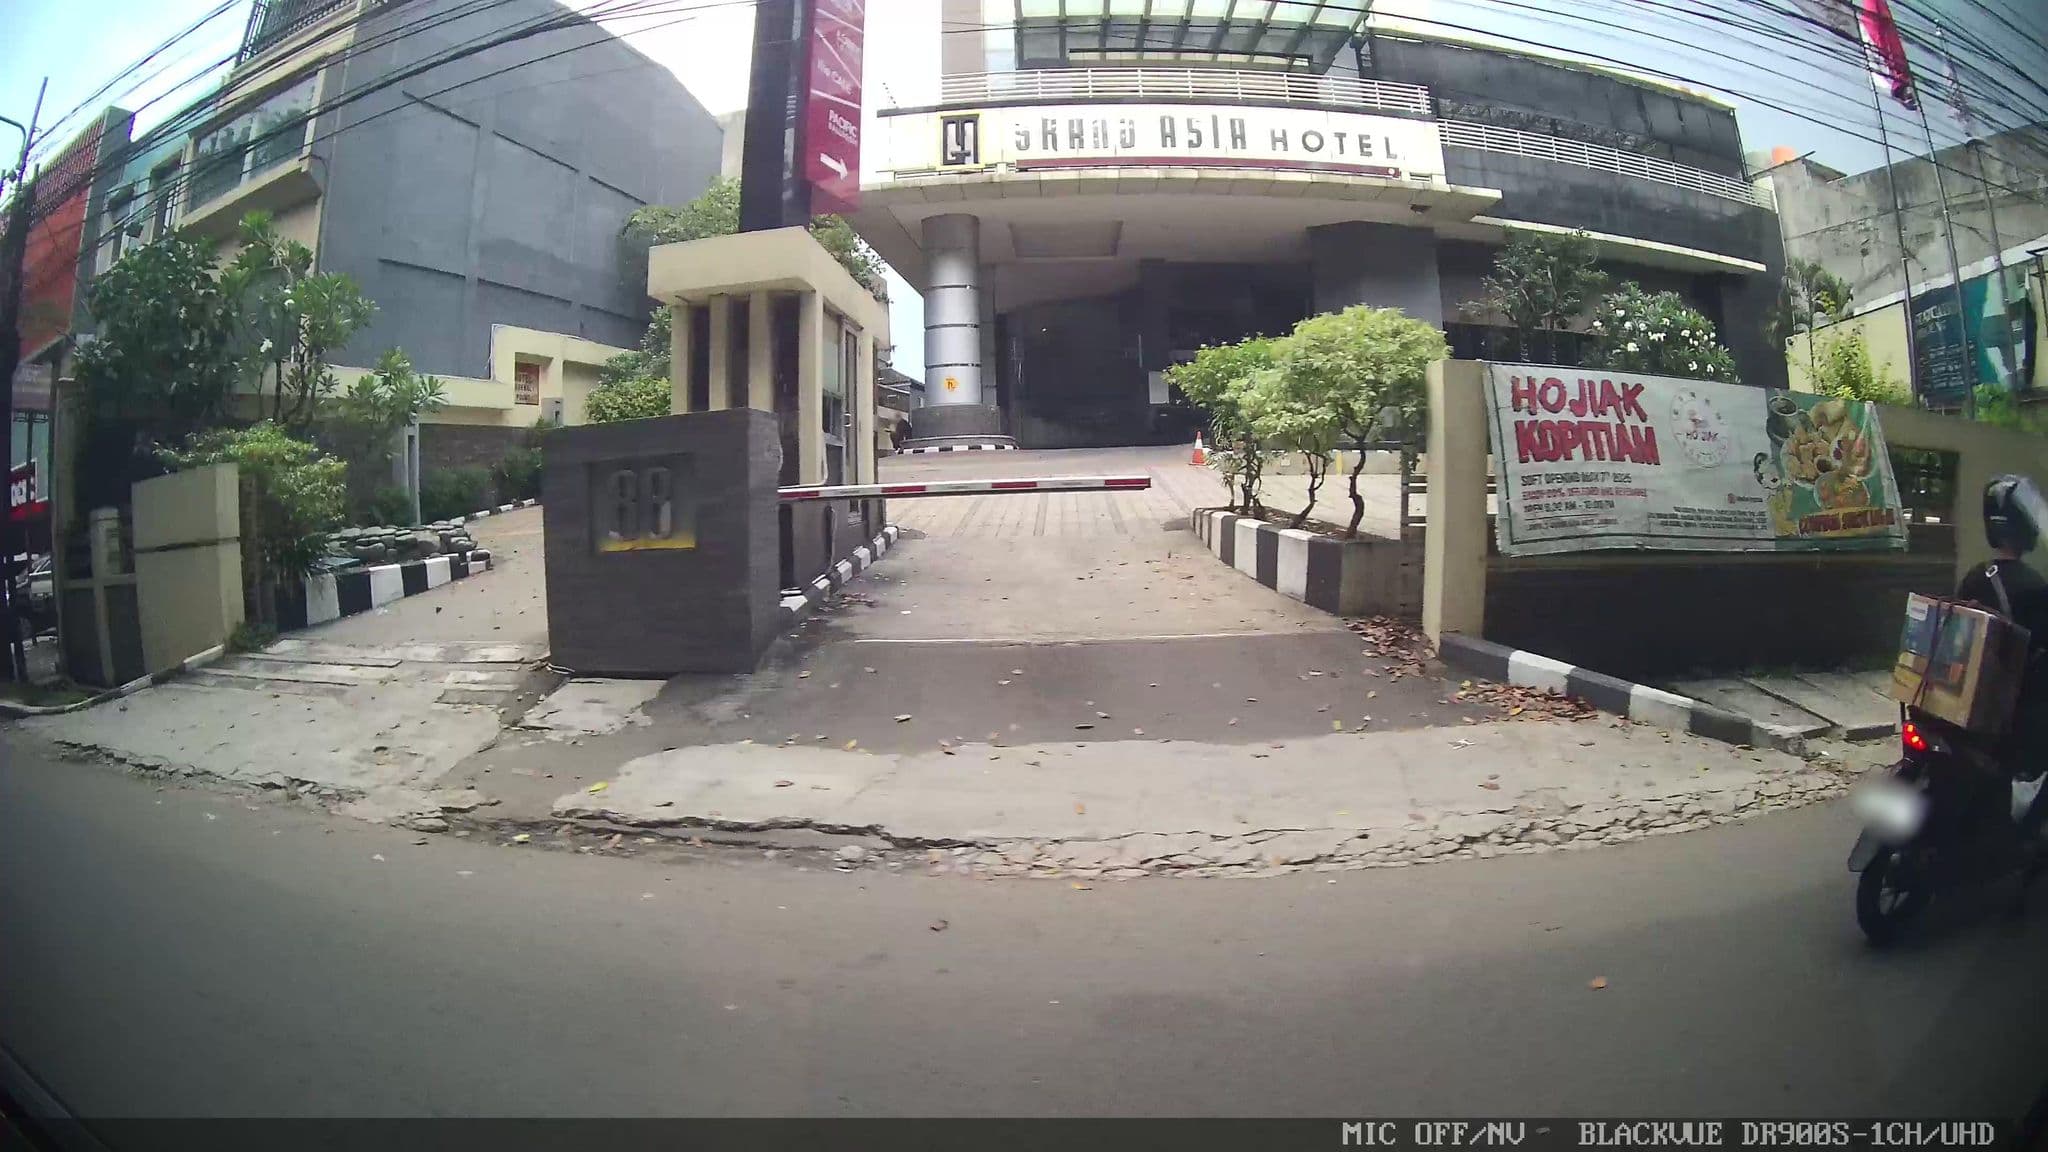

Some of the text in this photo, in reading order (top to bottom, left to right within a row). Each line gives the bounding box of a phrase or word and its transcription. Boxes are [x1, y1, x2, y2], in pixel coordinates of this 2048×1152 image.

[1160, 115, 1246, 150] ASIA
[1271, 127, 1400, 160] HOTEL
[1514, 419, 1661, 466] KOPITIAM
[1521, 473, 1542, 487] SOFT
